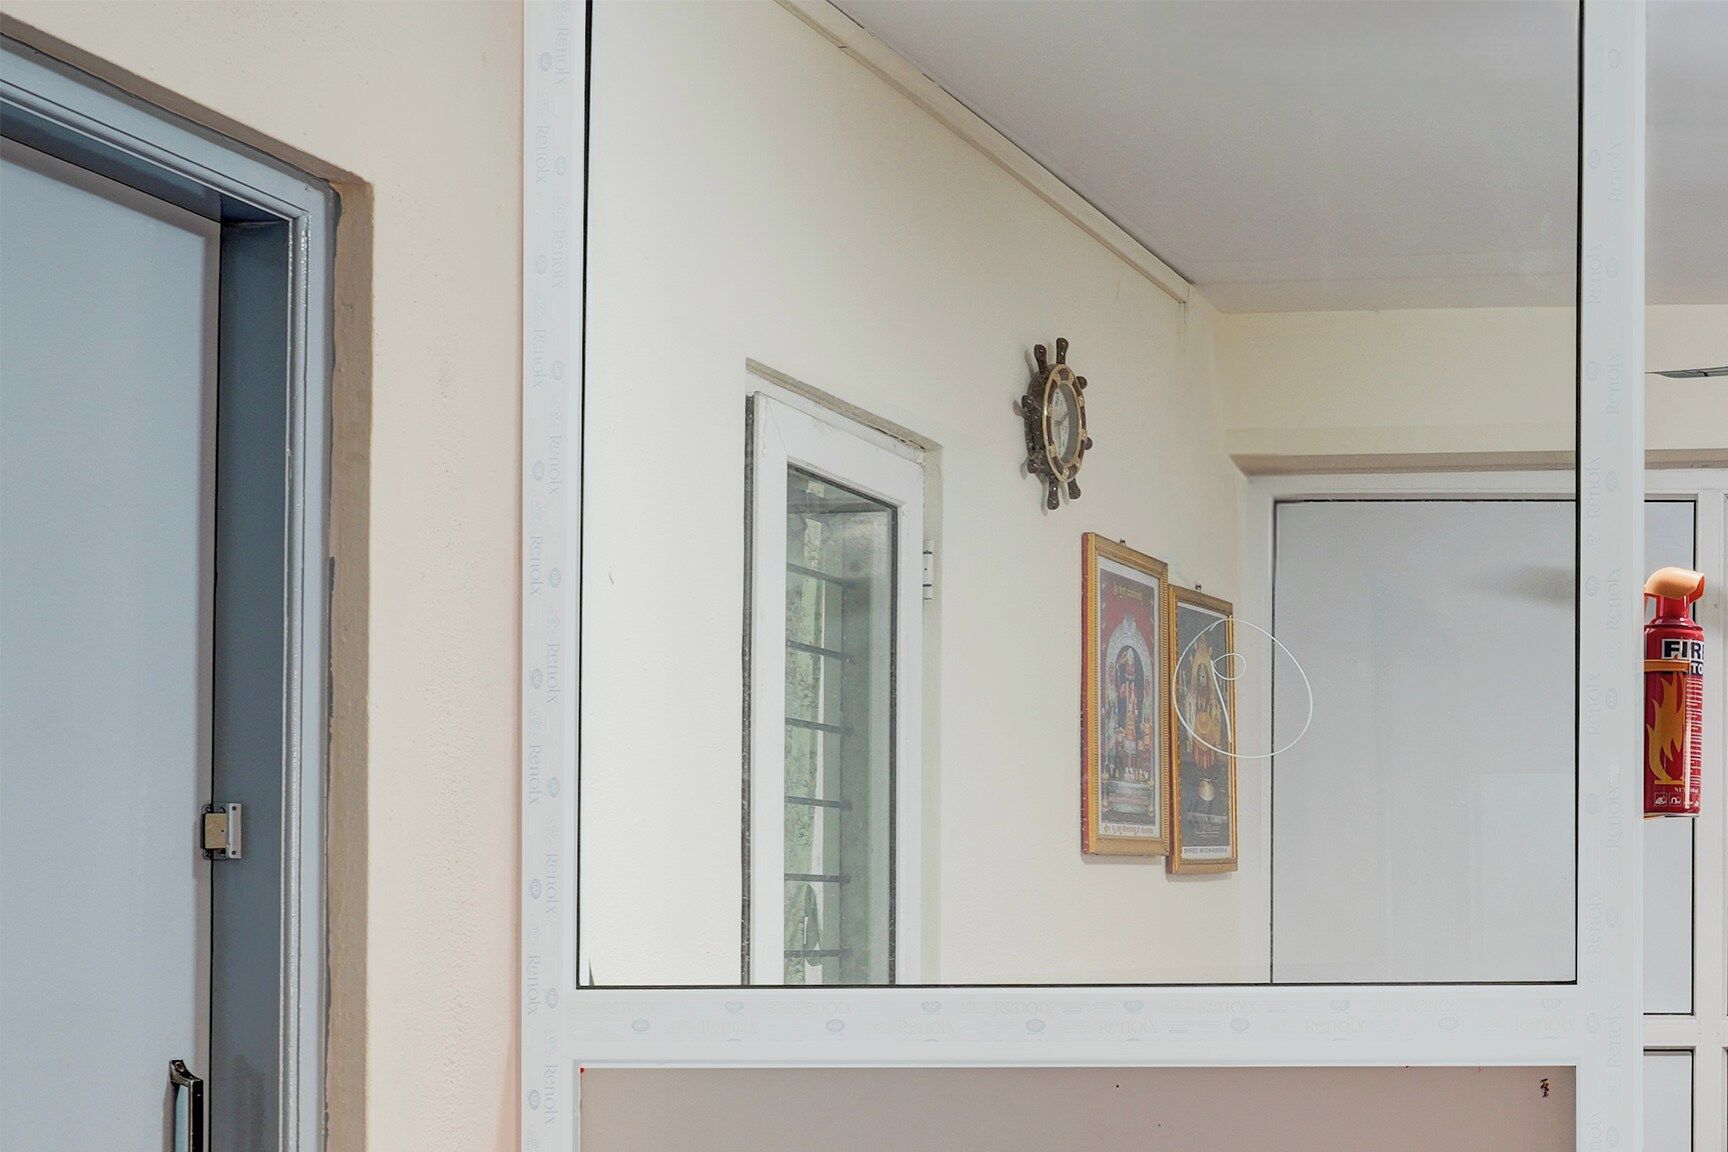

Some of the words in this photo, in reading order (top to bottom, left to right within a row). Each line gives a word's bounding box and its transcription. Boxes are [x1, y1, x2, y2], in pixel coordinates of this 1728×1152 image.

[554, 26, 570, 86] Renolx
[534, 124, 550, 184] Renolx
[1606, 141, 1623, 203] Renolx
[550, 229, 566, 289] Renolx
[531, 328, 547, 388] Renolx
[1604, 352, 1622, 416] Renolx
[547, 434, 564, 496] Renolx
[1604, 567, 1622, 631] Renolx
[545, 642, 562, 704] Renolx
[1664, 641, 1704, 660] FIR
[527, 744, 544, 806] Renolx
[525, 954, 542, 1016] Renolx
[542, 1063, 559, 1125] Renolx
